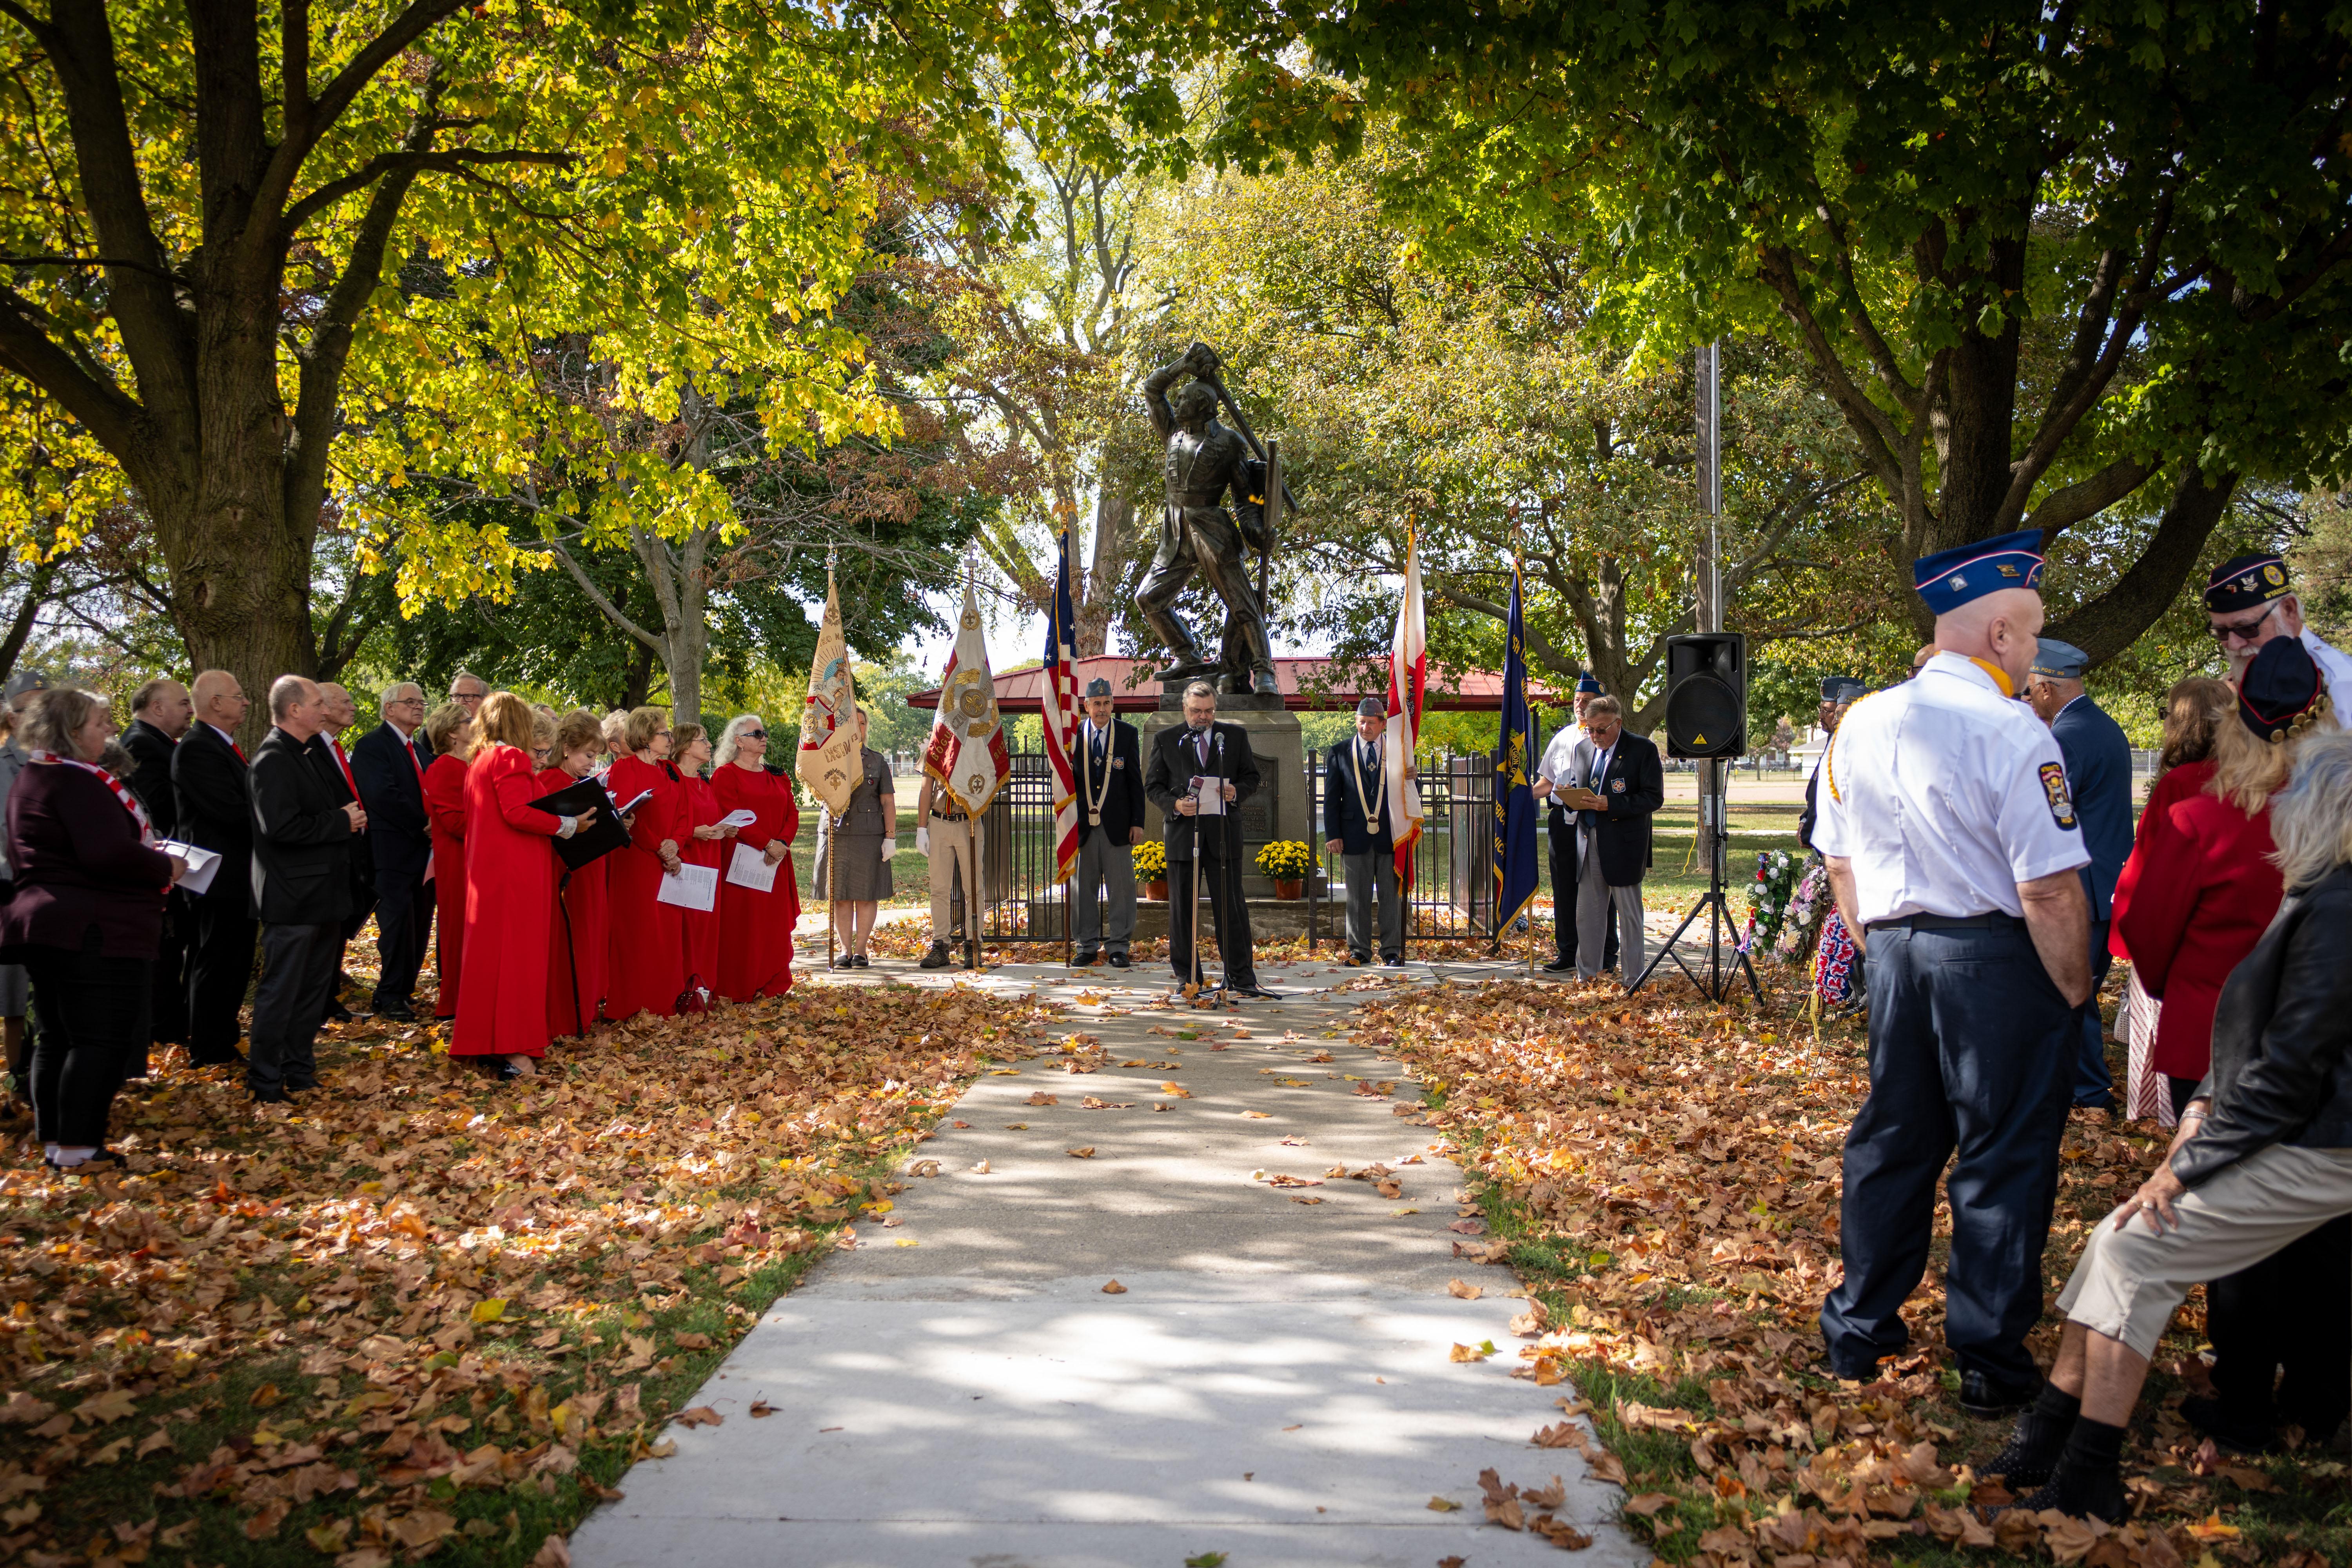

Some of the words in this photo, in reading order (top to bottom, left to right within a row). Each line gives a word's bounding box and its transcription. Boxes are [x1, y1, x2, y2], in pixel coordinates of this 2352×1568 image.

[950, 711, 967, 730] CZU
[824, 739, 851, 763] POLSKI
[931, 730, 952, 761] BOGU
[1510, 744, 1519, 764] LEGION
